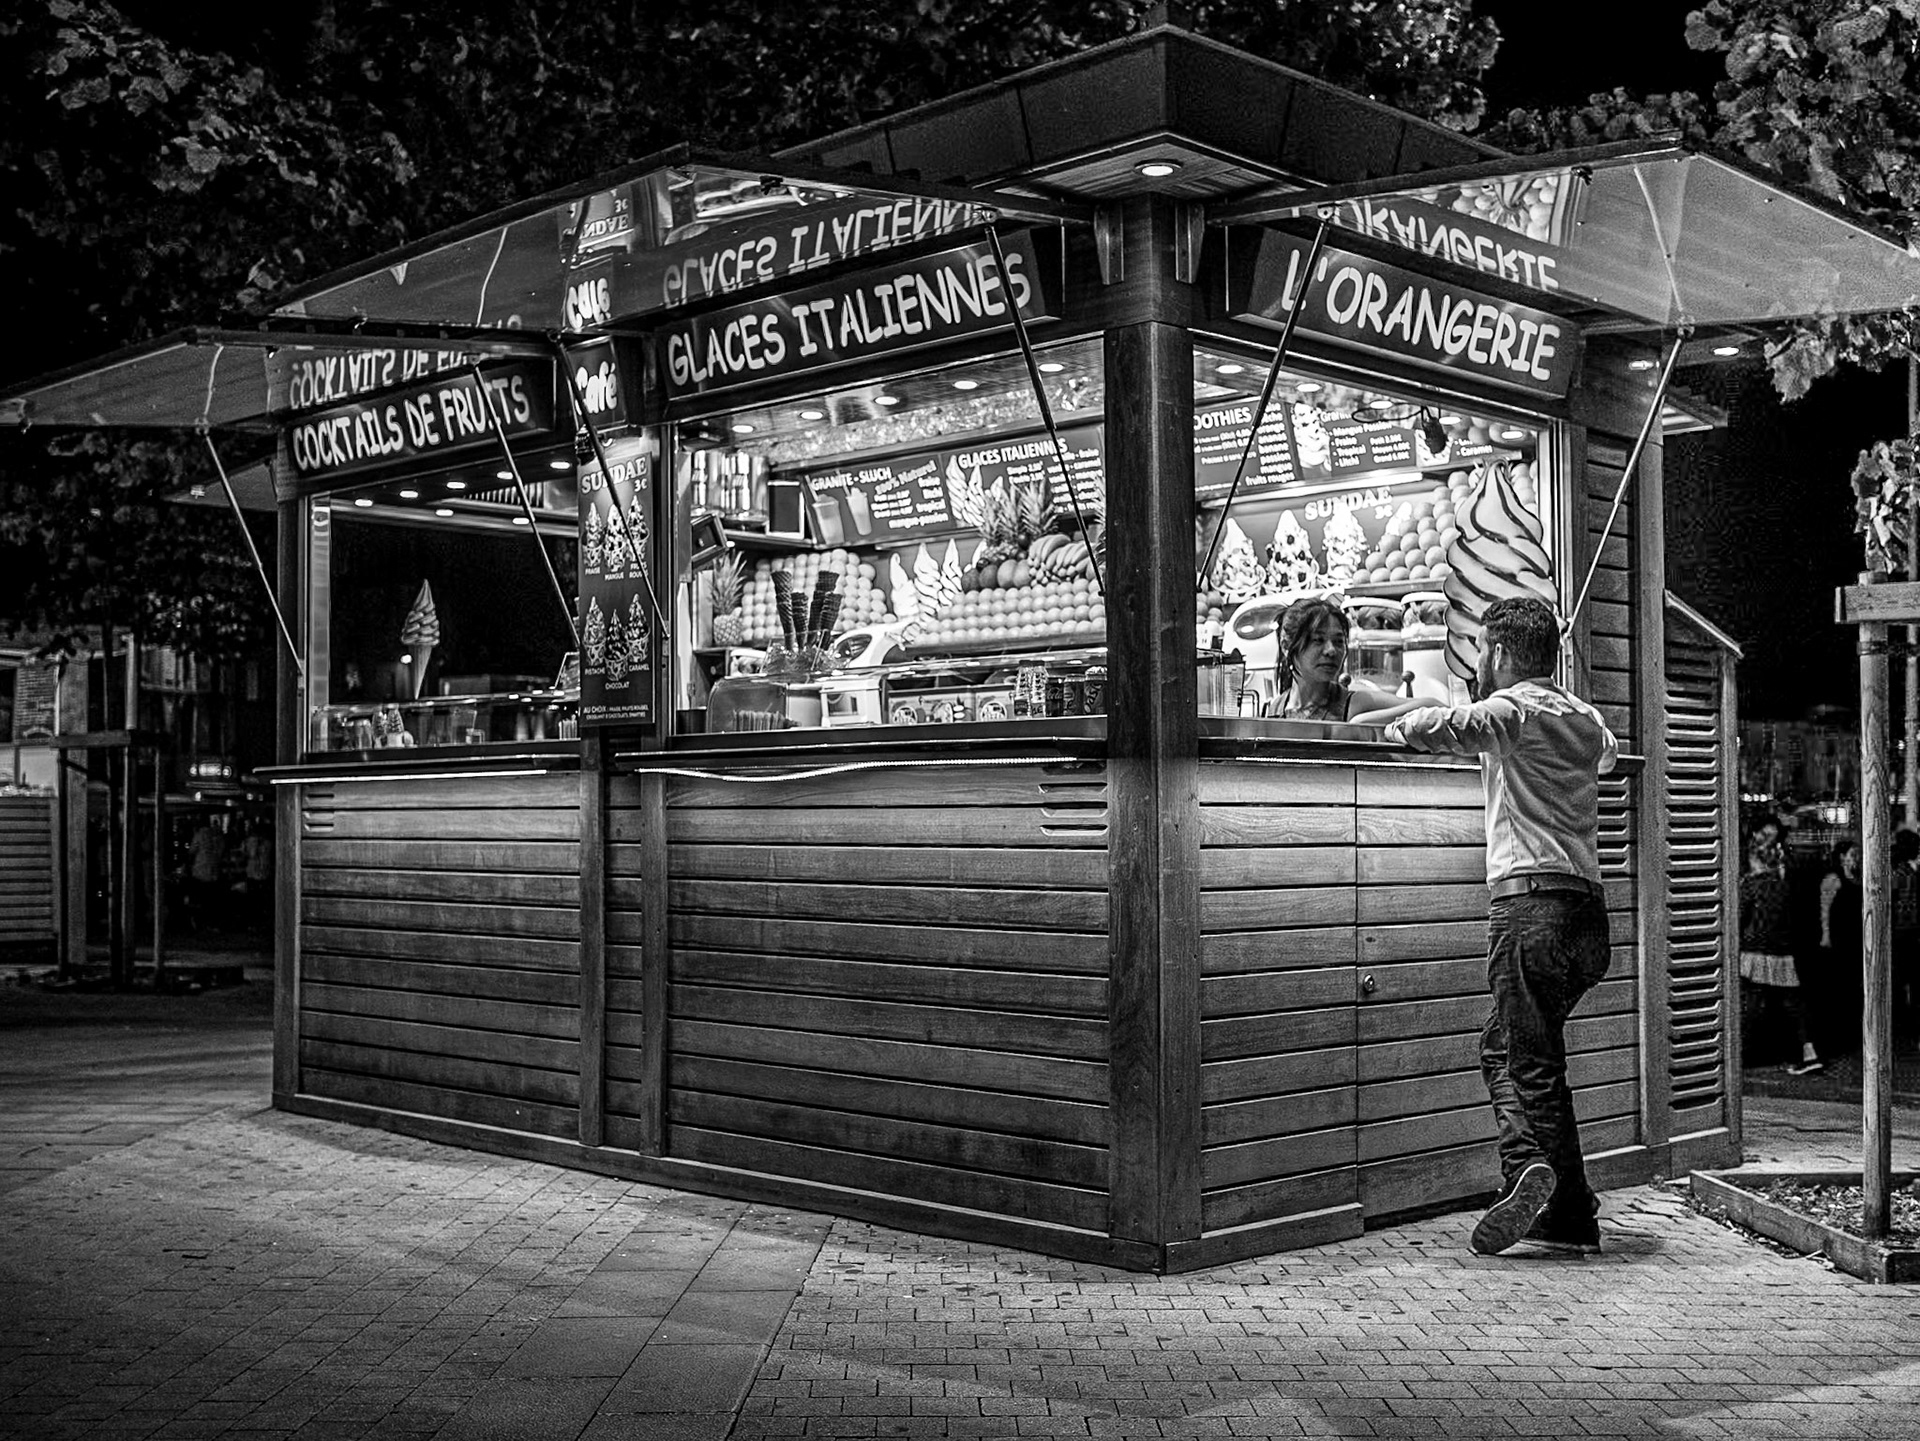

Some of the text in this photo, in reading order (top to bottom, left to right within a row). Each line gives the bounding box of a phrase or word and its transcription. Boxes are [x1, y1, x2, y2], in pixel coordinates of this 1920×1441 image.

[667, 253, 1032, 386] GLACES ITALIENNES
[1281, 249, 1560, 381] L'ORANGERIE
[293, 404, 404, 471] COCKTAILS
[404, 393, 440, 448] DE
[958, 437, 1068, 469] GLACES ITALIENNS
[1193, 406, 1252, 431] OOTHIES
